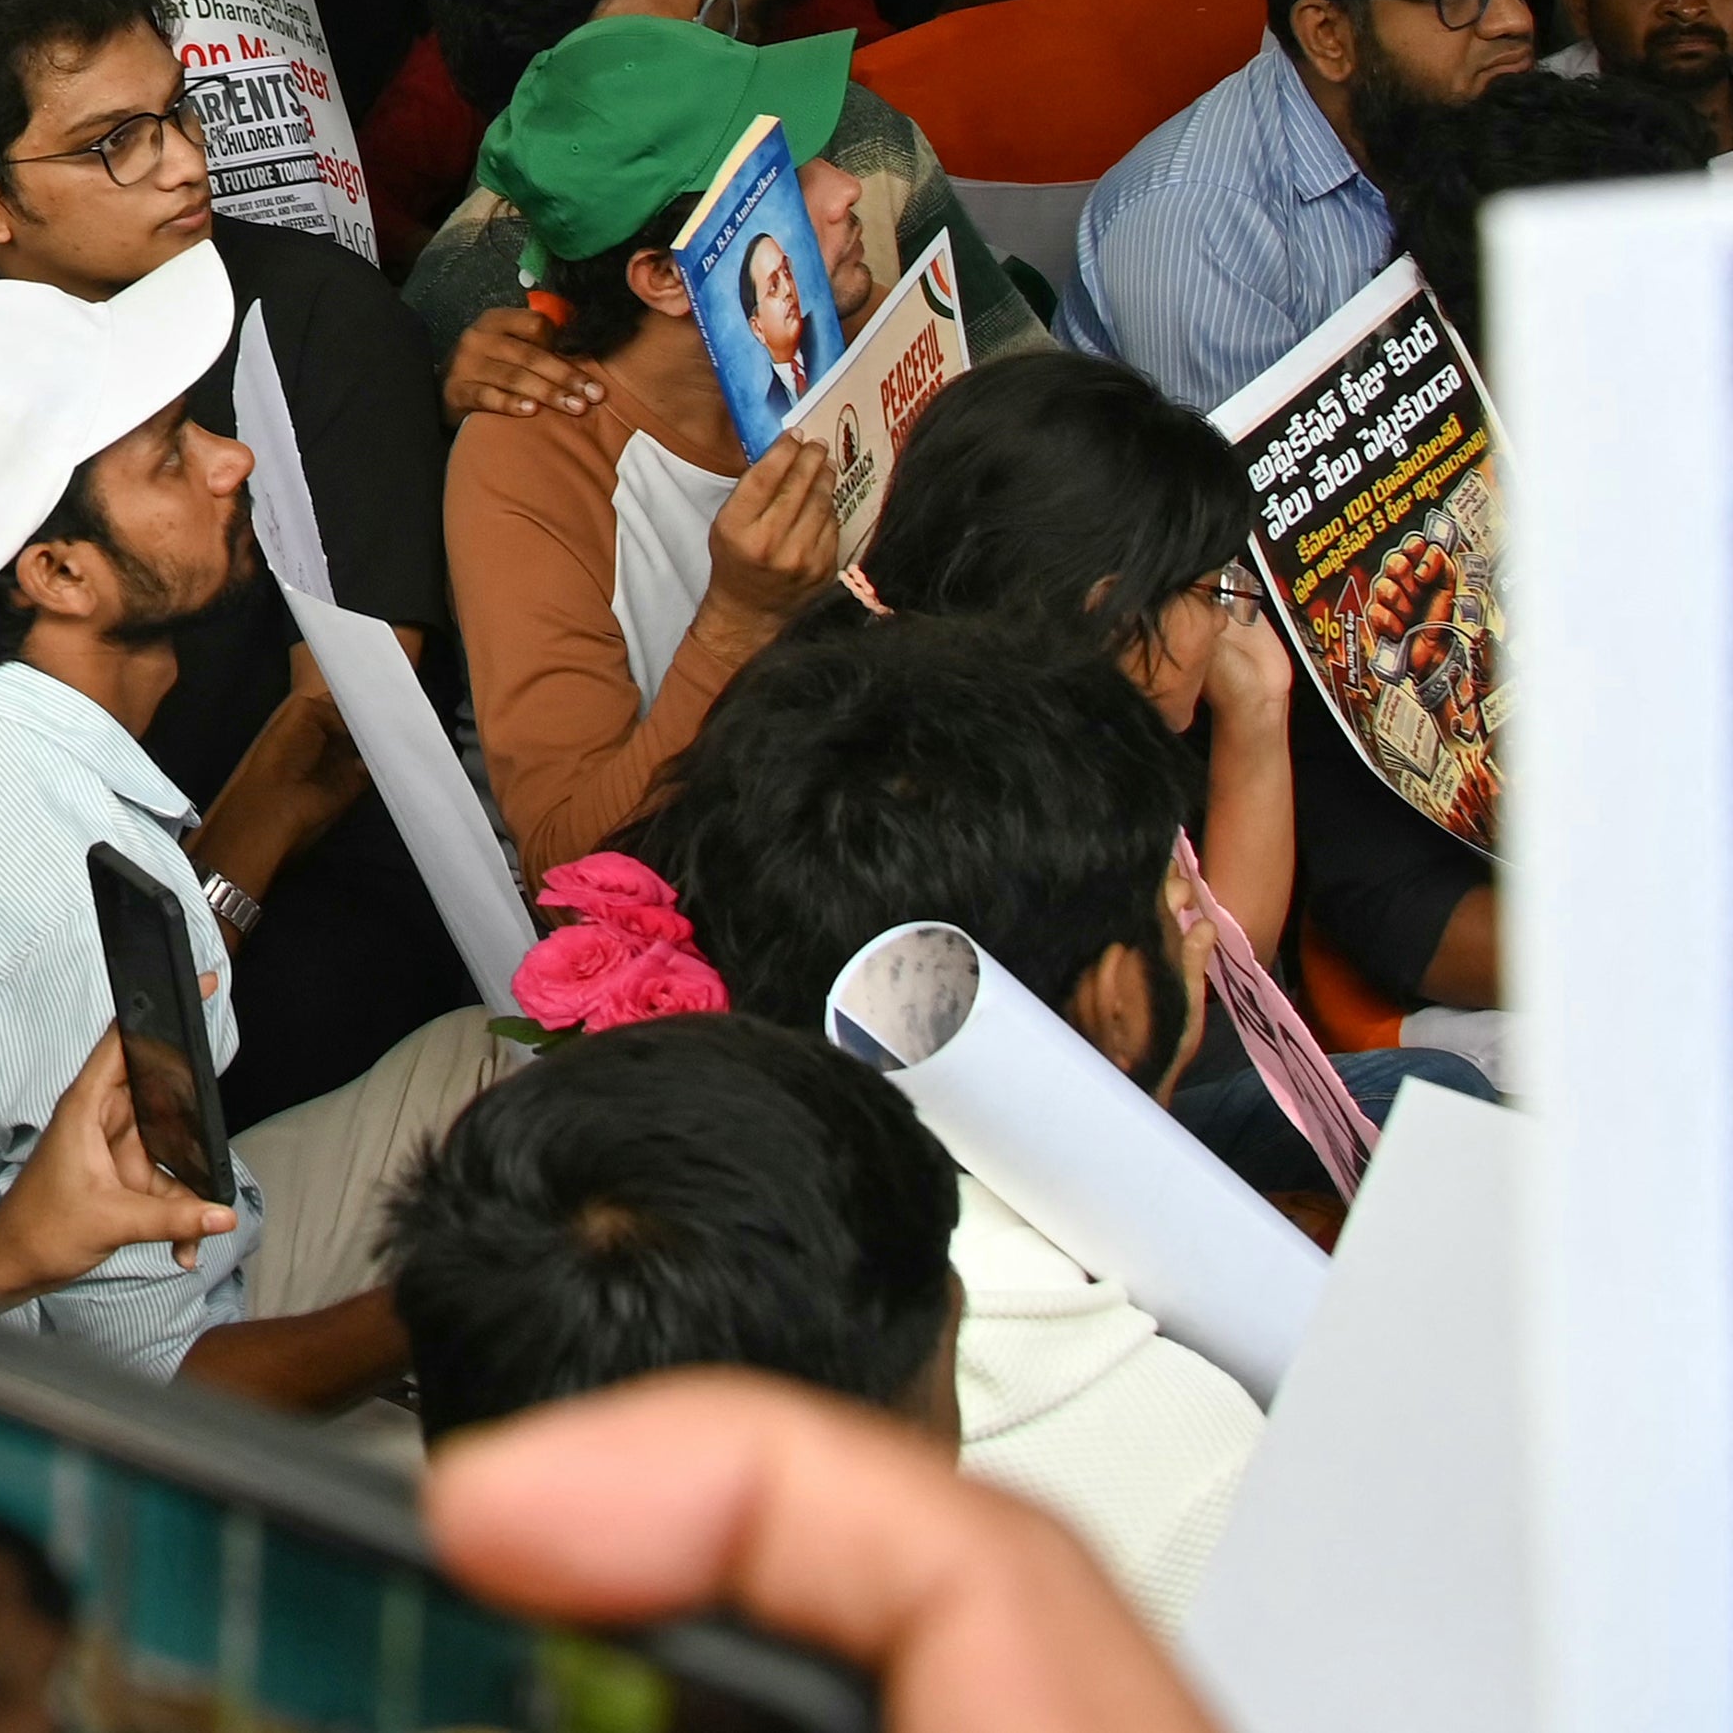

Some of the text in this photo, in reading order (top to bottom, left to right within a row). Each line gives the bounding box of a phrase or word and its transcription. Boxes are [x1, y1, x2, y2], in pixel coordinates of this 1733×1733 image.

[220, 124, 282, 157] CHILDREN
[224, 164, 277, 193] FUTURE
[702, 166, 778, 273] Dr. B.R. Ambedkar
[880, 319, 944, 432] PEACEFUL
[1248, 317, 1438, 492] అప్లికేషన్ ఫీజు కింద
[1261, 363, 1462, 541] వేలు వేలు పెట్టకుండా
[1296, 517, 1345, 565] కేవలం
[1344, 491, 1375, 526] 100
